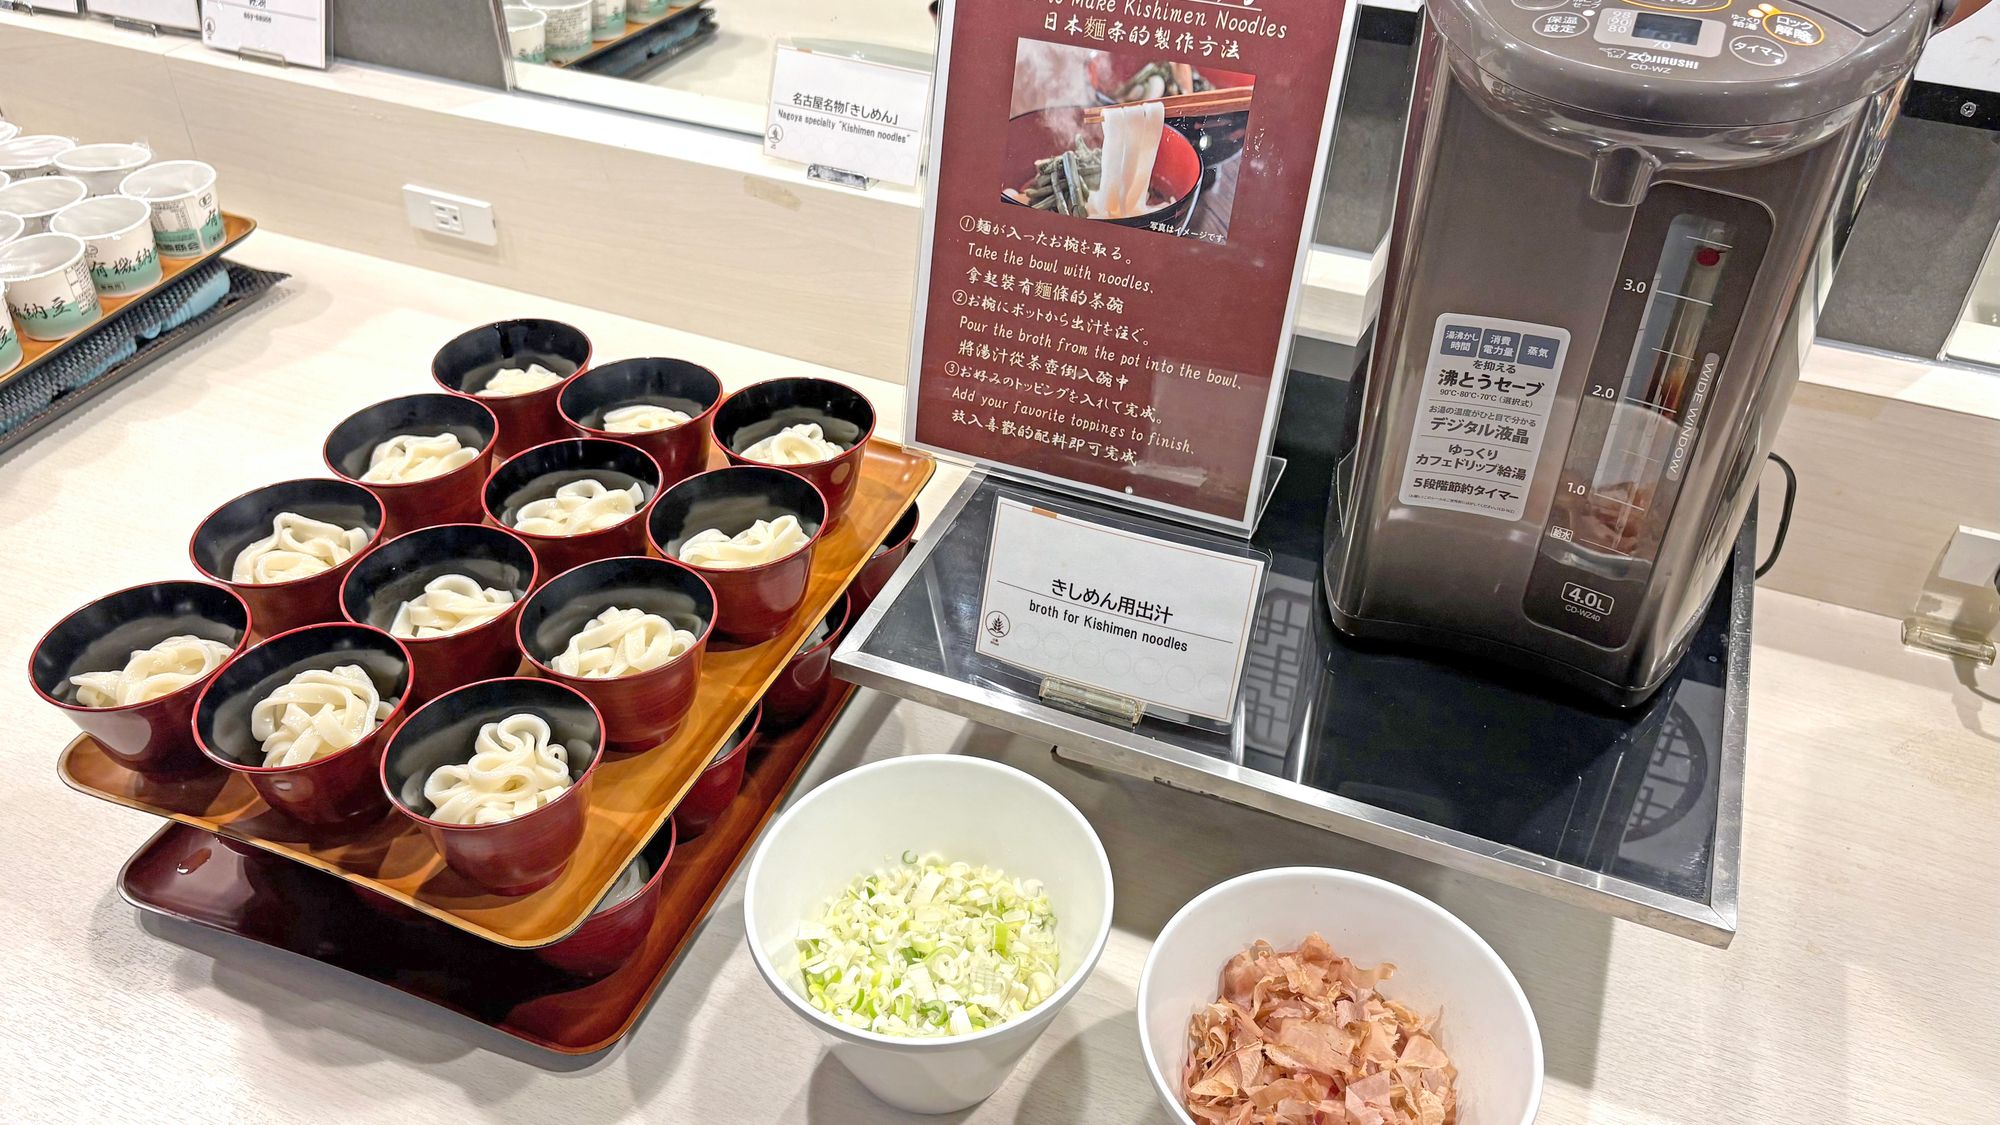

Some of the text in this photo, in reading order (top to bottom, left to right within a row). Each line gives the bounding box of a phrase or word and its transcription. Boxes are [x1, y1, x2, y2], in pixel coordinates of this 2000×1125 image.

[1124, 0, 1207, 27] Kishimen
[1215, 9, 1287, 39] Noodles
[1543, 24, 1577, 34] 設定
[1776, 15, 1814, 30] ロック
[1607, 25, 1627, 34] 80
[1652, 40, 1672, 50] 70
[1734, 41, 1784, 58] タイマー
[1626, 51, 1700, 70] ZOJIRUSHI
[1630, 63, 1672, 74] CD-WZ
[792, 92, 899, 125] 名古屋名物「きしめん」
[778, 109, 803, 123] Nagoya
[804, 116, 836, 130] specialty
[1150, 221, 1225, 243] 写真はイメージです
[967, 242, 1154, 294] Take the bowl with noodles.
[1623, 278, 1647, 293] 3.0
[1450, 341, 1472, 352] 時間
[1489, 334, 1512, 346] 消費
[959, 315, 1242, 390] Pour the broth from the pot into the bowl.
[1482, 345, 1515, 357] 電力量
[1527, 345, 1550, 358] 蒸気
[1472, 359, 1517, 374] を抑える
[1437, 369, 1545, 397] 沸とうセーブ
[1592, 384, 1615, 399] 2.0
[952, 386, 1195, 455] Add your favorite toppings to finish.
[1428, 405, 1537, 427] お湯の温度がひと目で分かる
[1669, 362, 1716, 474] WIDE WINDOW
[1430, 416, 1529, 445] デジタル液晶
[1448, 443, 1498, 461] ゆっくり
[1415, 454, 1527, 481] カフェドリップ給湯
[1413, 477, 1519, 501] 5段階節約タイマー
[1567, 482, 1586, 496] 1.0
[1051, 578, 1174, 625] きしめん用出汁
[1568, 587, 1605, 612] 4.0L
[1565, 604, 1601, 622] CD-WZ40
[1029, 599, 1188, 653] broth for Kishimen noodles
